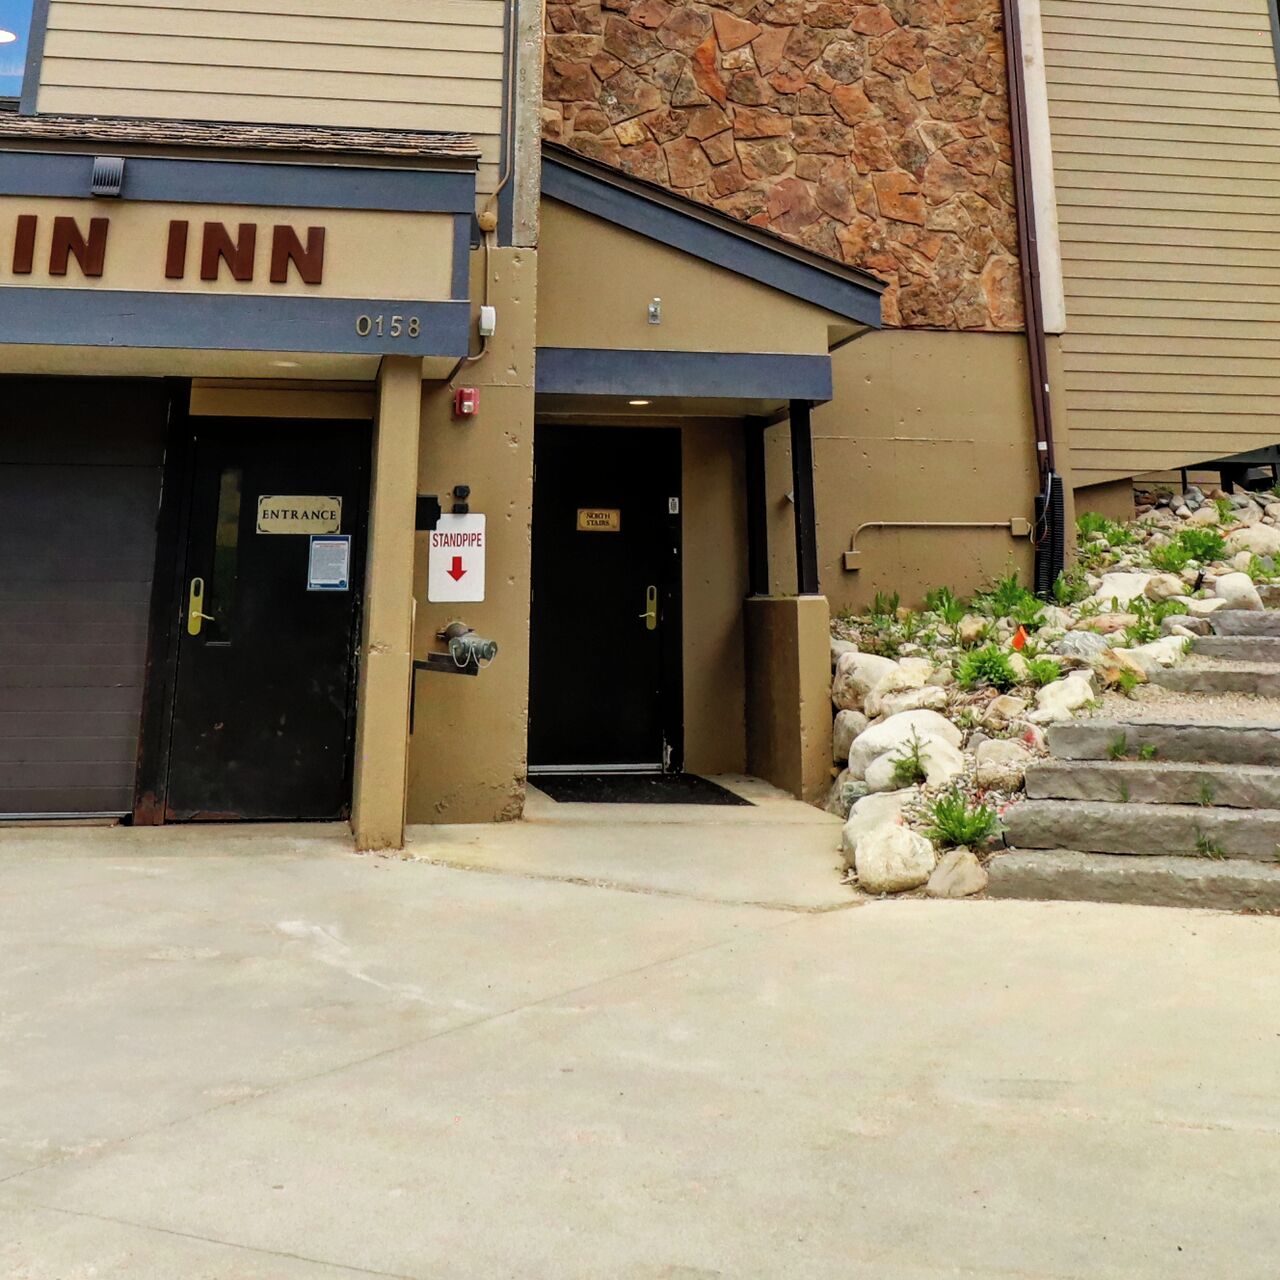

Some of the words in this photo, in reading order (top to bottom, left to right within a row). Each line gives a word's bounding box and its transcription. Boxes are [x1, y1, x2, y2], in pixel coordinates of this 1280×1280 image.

[165, 219, 326, 285] INN
[356, 314, 420, 337] 0158
[261, 509, 337, 521] ENTRANCE
[432, 532, 482, 548] STANDPIPE
